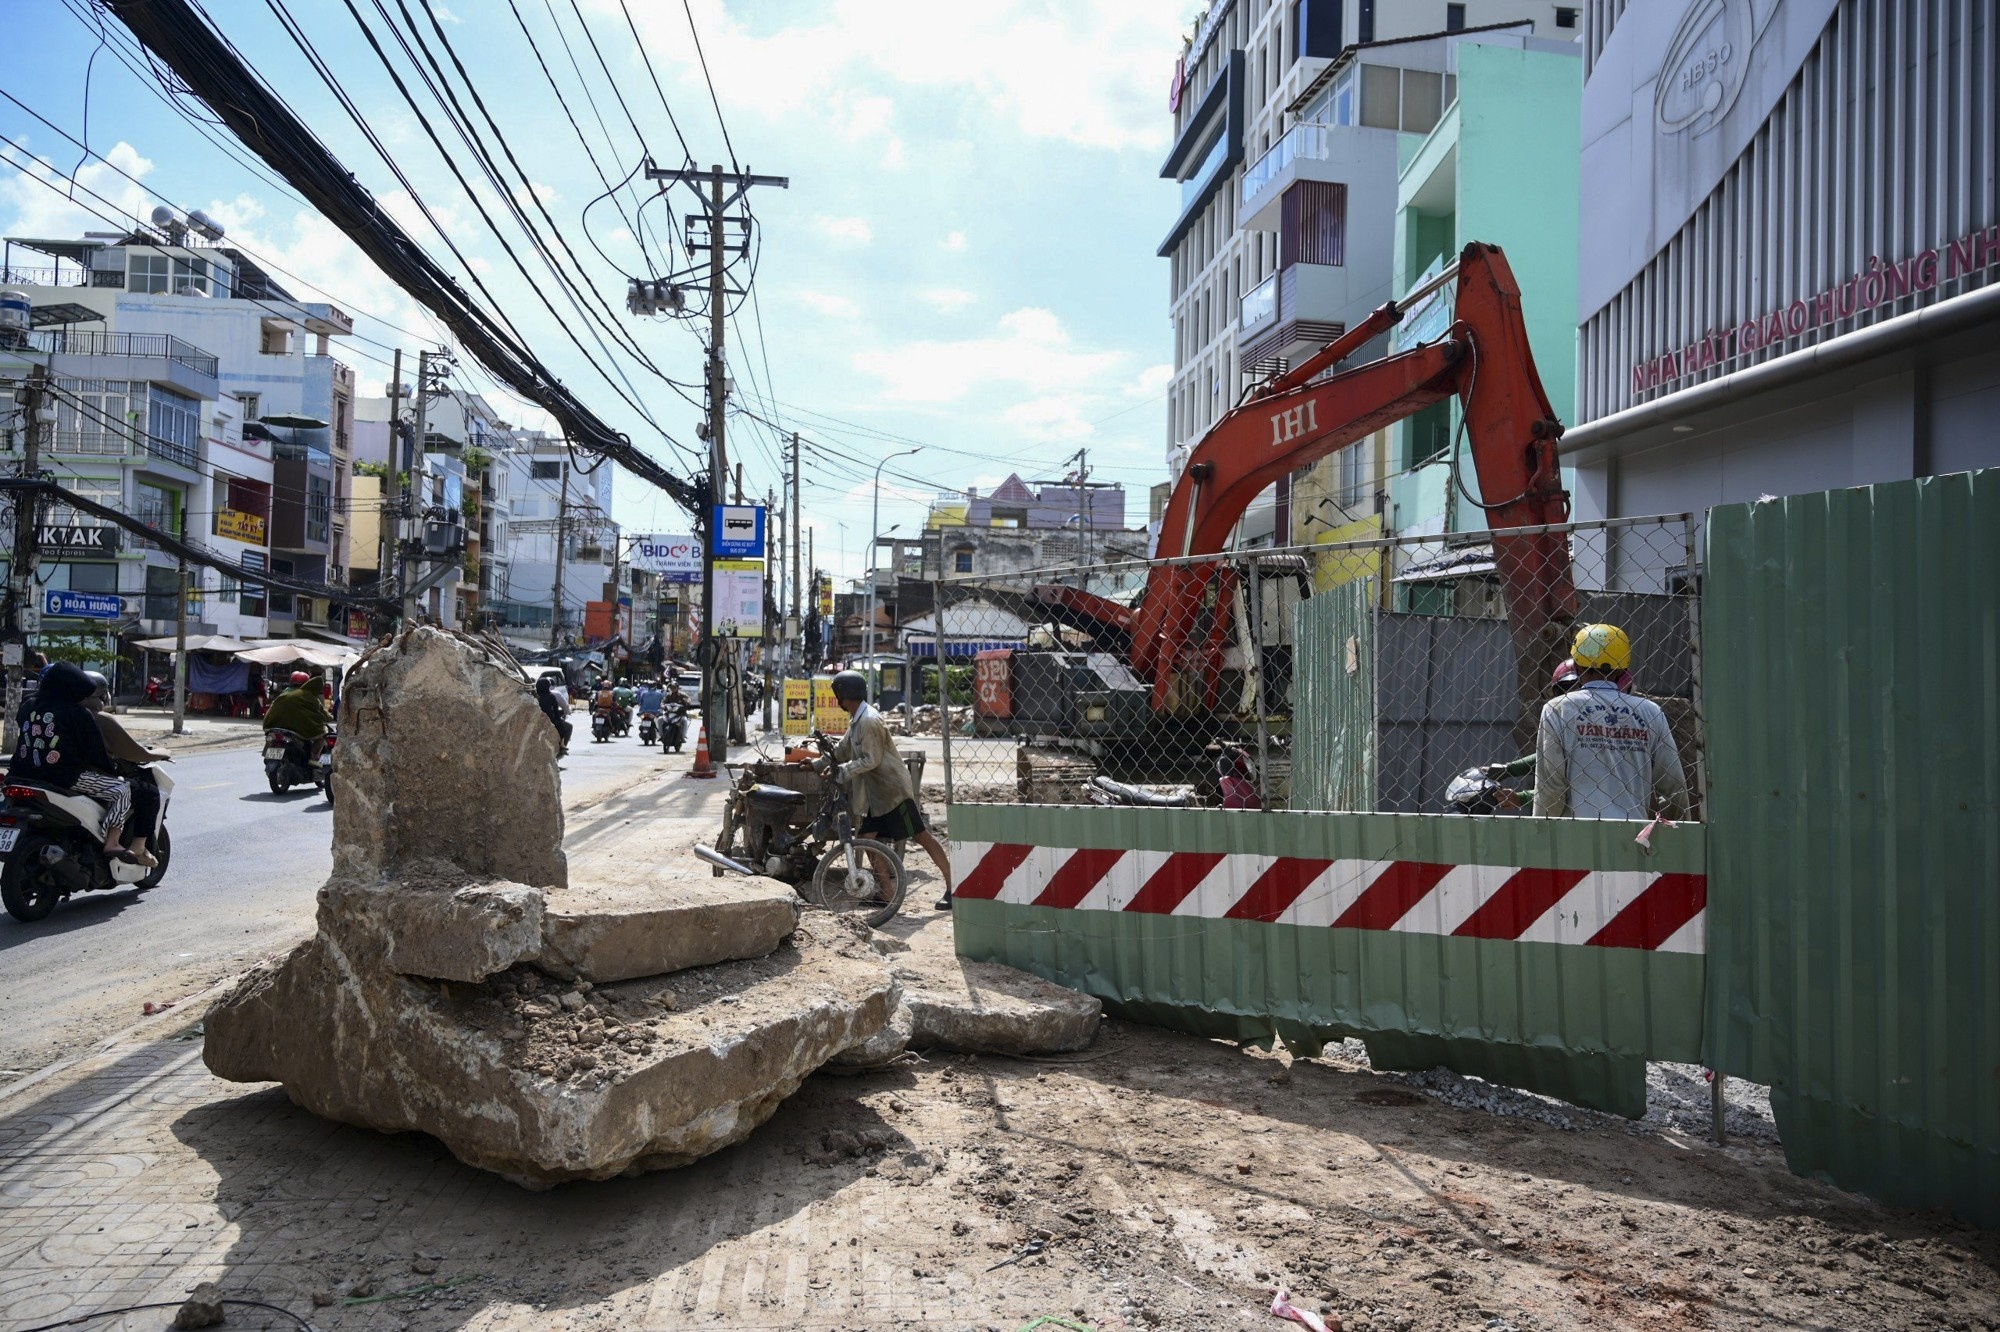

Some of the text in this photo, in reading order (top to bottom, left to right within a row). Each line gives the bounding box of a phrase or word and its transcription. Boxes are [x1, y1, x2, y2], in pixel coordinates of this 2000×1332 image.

[1682, 42, 1732, 92] HBSO
[1633, 223, 2000, 394] NHÀ HÁT GIAO HƯỞNG NH
[1271, 399, 1318, 446] IHI
[57, 549, 86, 557] Express
[65, 598, 86, 610] HÒA
[90, 600, 117, 612] HƯNG
